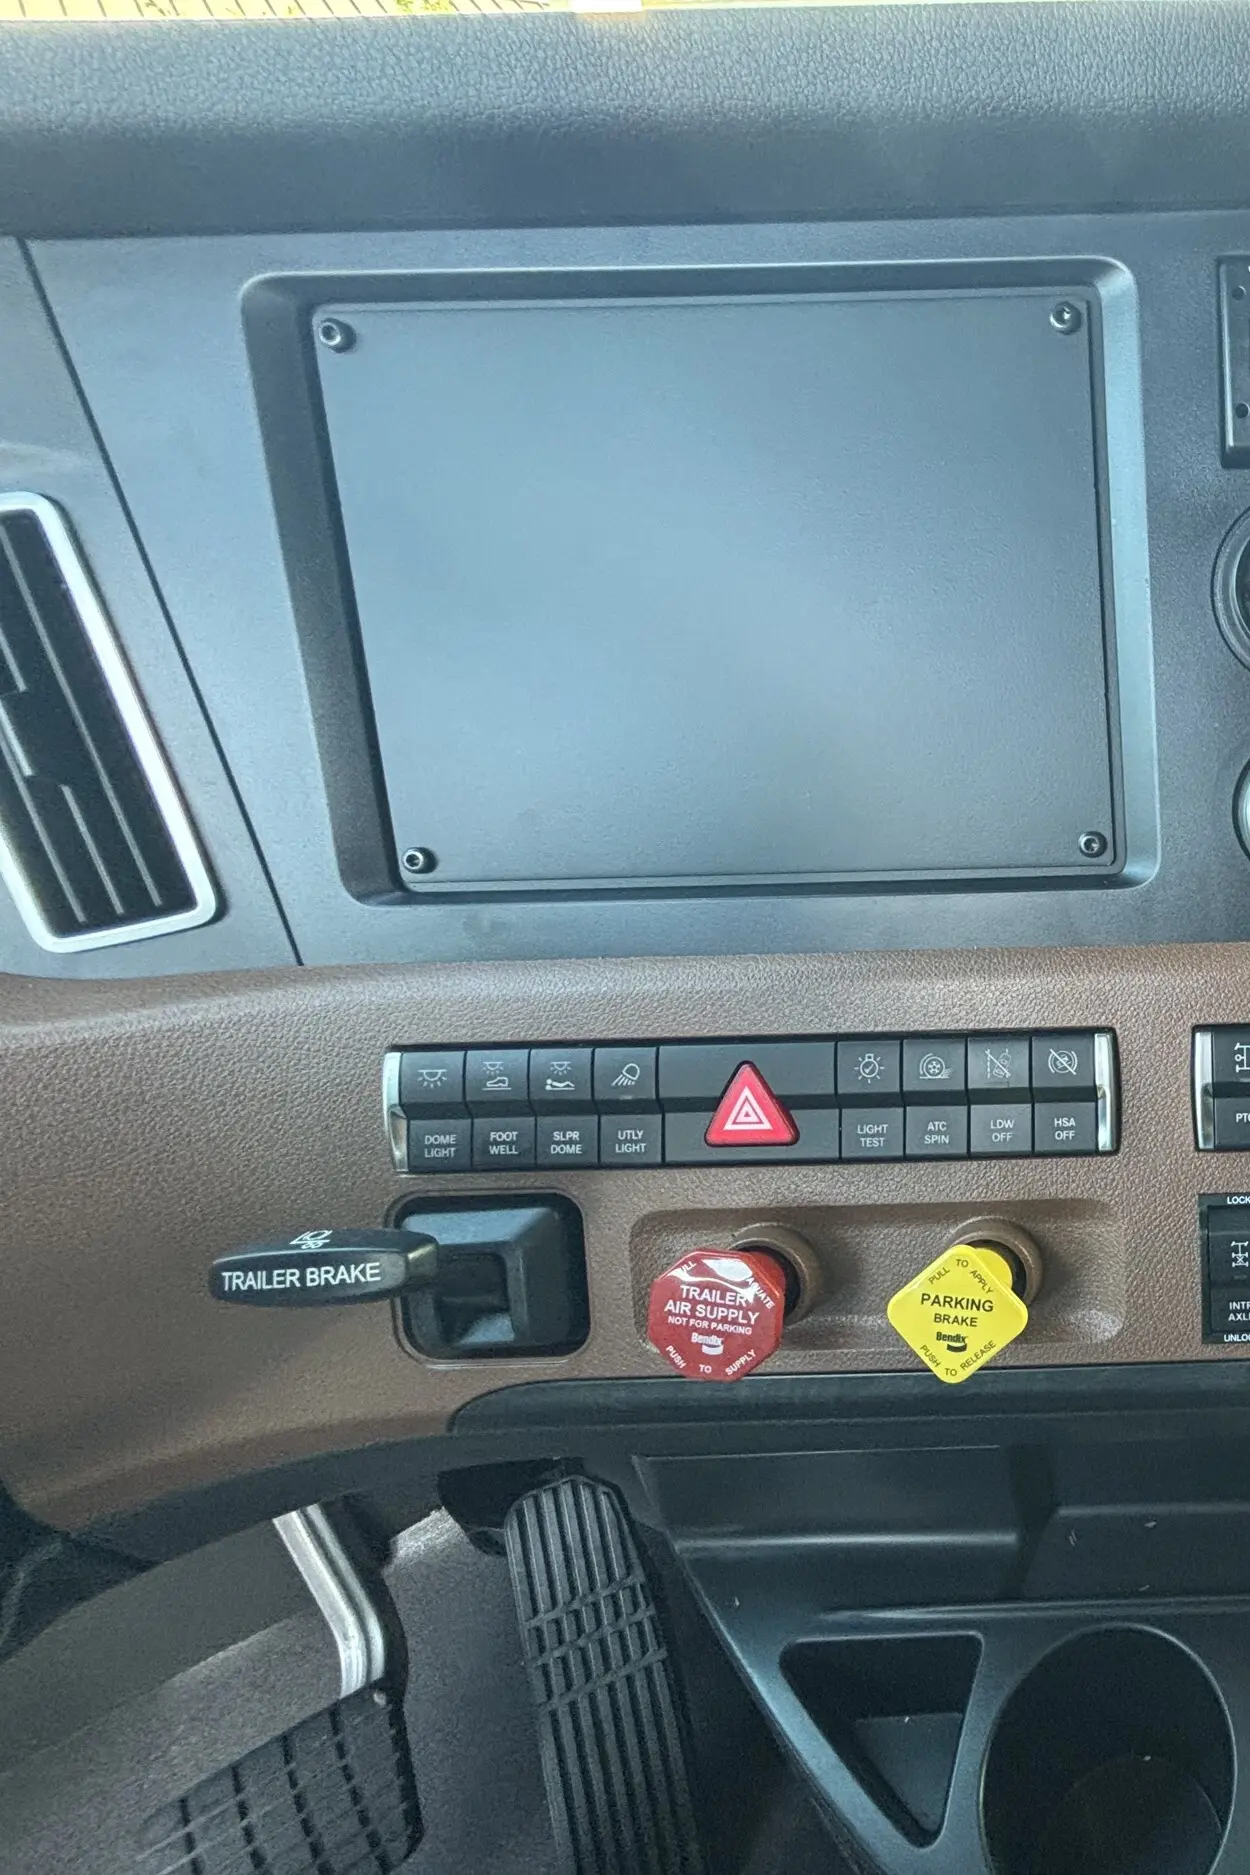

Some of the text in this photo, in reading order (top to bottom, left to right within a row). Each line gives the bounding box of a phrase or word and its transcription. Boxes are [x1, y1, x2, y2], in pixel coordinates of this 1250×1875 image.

[926, 1120, 948, 1132] ATC
[989, 1118, 1016, 1131] LDW
[1053, 1116, 1077, 1129] HSA
[552, 1130, 580, 1141] SLPR
[617, 1129, 645, 1140] UTLY
[857, 1123, 889, 1136] LIGHT
[1054, 1129, 1077, 1141] OFF
[424, 1134, 457, 1145] DOME
[489, 1131, 519, 1142] FOOT
[859, 1136, 885, 1148] TEST
[924, 1132, 950, 1145] SPIN
[991, 1130, 1014, 1143] OFF
[424, 1147, 457, 1158] LIGHT
[488, 1144, 519, 1155] WELL
[550, 1143, 583, 1154] DOME
[615, 1142, 647, 1153] LIGHT
[221, 1261, 381, 1292] TRAILER BRAKE
[927, 1258, 995, 1296] PULL TO APPLY
[679, 1284, 748, 1309] TRAILER
[920, 1292, 995, 1313] PARKING
[664, 1299, 760, 1325] AIR SUPPLY
[667, 1315, 753, 1336] NOT FOR PARKING
[933, 1312, 979, 1328] BRAKE
[691, 1331, 724, 1346] Bendix
[935, 1331, 968, 1344] Bendix
[665, 1344, 758, 1377] PUSH TO SUPPLY
[919, 1339, 997, 1377] PUSH TO RELEASE
